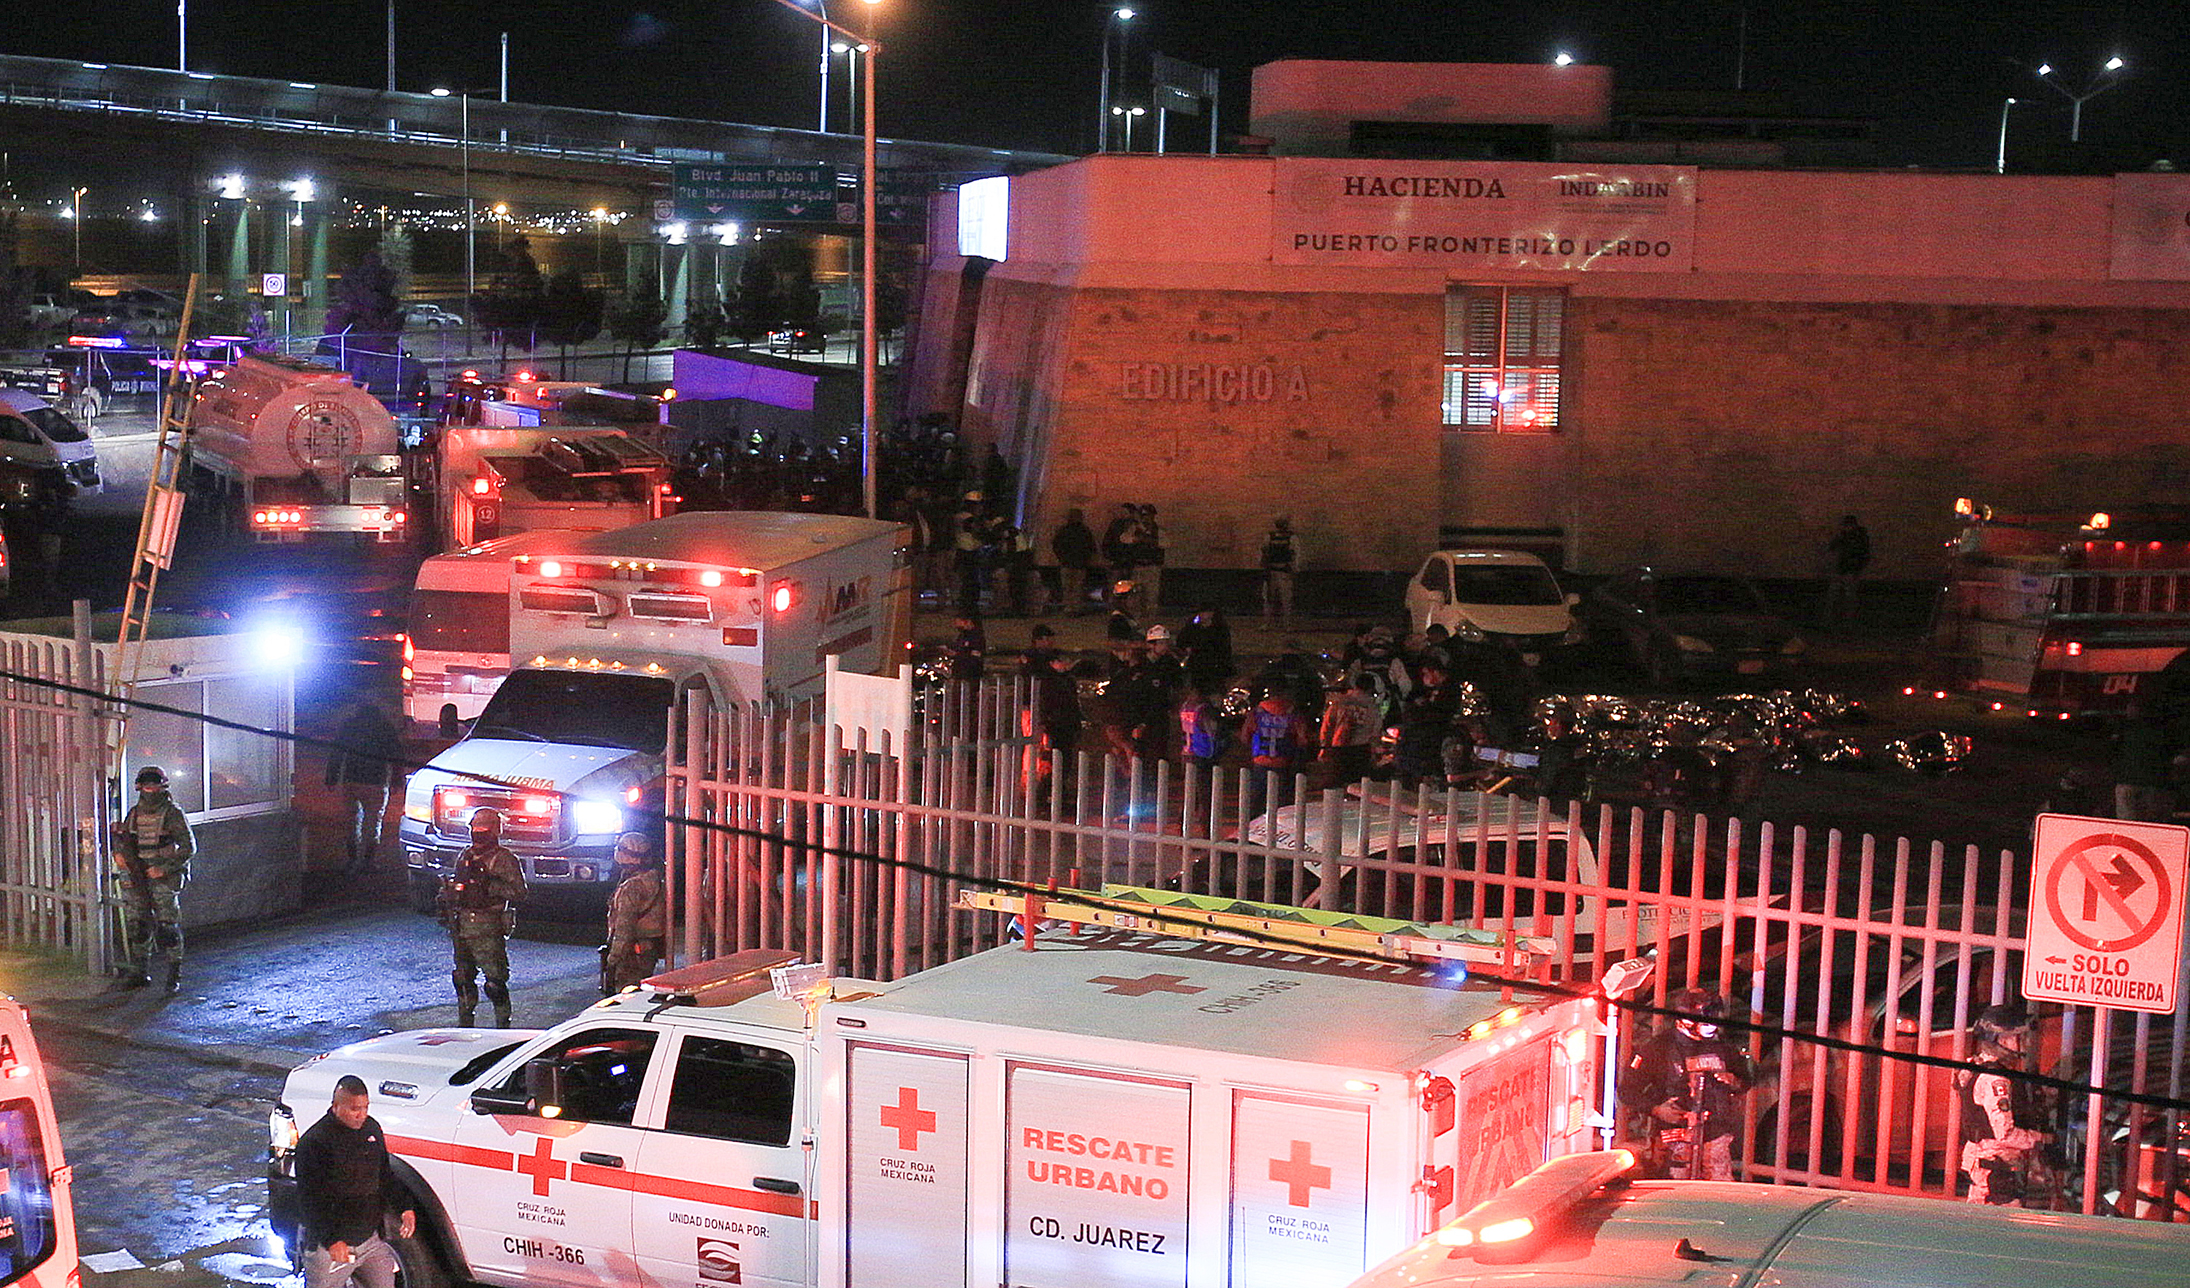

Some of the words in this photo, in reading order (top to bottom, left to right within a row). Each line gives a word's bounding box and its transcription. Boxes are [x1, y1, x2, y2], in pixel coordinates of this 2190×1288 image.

[730, 170, 761, 182] Juan
[767, 170, 804, 182] Pablo
[1343, 175, 1506, 199] HACIENDA
[1294, 234, 1398, 252] PUERTO
[1407, 235, 1575, 257] FRONTERIZO
[1584, 241, 1671, 258] LERDO
[1122, 363, 1274, 401] EDIFICIO
[1288, 365, 1309, 401] A
[480, 510, 492, 519] 12
[2072, 954, 2130, 976] SOLO
[2036, 970, 2086, 994] VUELTA
[2090, 976, 2164, 1002] IZQUIERDA
[1023, 1127, 1175, 1168] RESCATE
[880, 1158, 905, 1169] CRUZ
[910, 1161, 936, 1173] ROJA
[881, 1168, 935, 1183] MEXICANA
[1027, 1160, 1169, 1200] URBANO
[517, 1202, 540, 1213] CRUZ
[543, 1206, 566, 1217] ROJA
[518, 1212, 566, 1227] MEXICANA
[669, 1212, 702, 1227] UNIDAD
[704, 1217, 744, 1234] DONADA
[746, 1225, 770, 1238] POR:
[1268, 1214, 1296, 1227] CRUZ
[1302, 1220, 1330, 1232] ROJA
[1269, 1226, 1329, 1243] MEXICANA
[1029, 1216, 1065, 1240] CD.
[1073, 1223, 1166, 1255] JUAREZ
[503, 1236, 544, 1259] CHIH
[548, 1245, 585, 1266] -366
